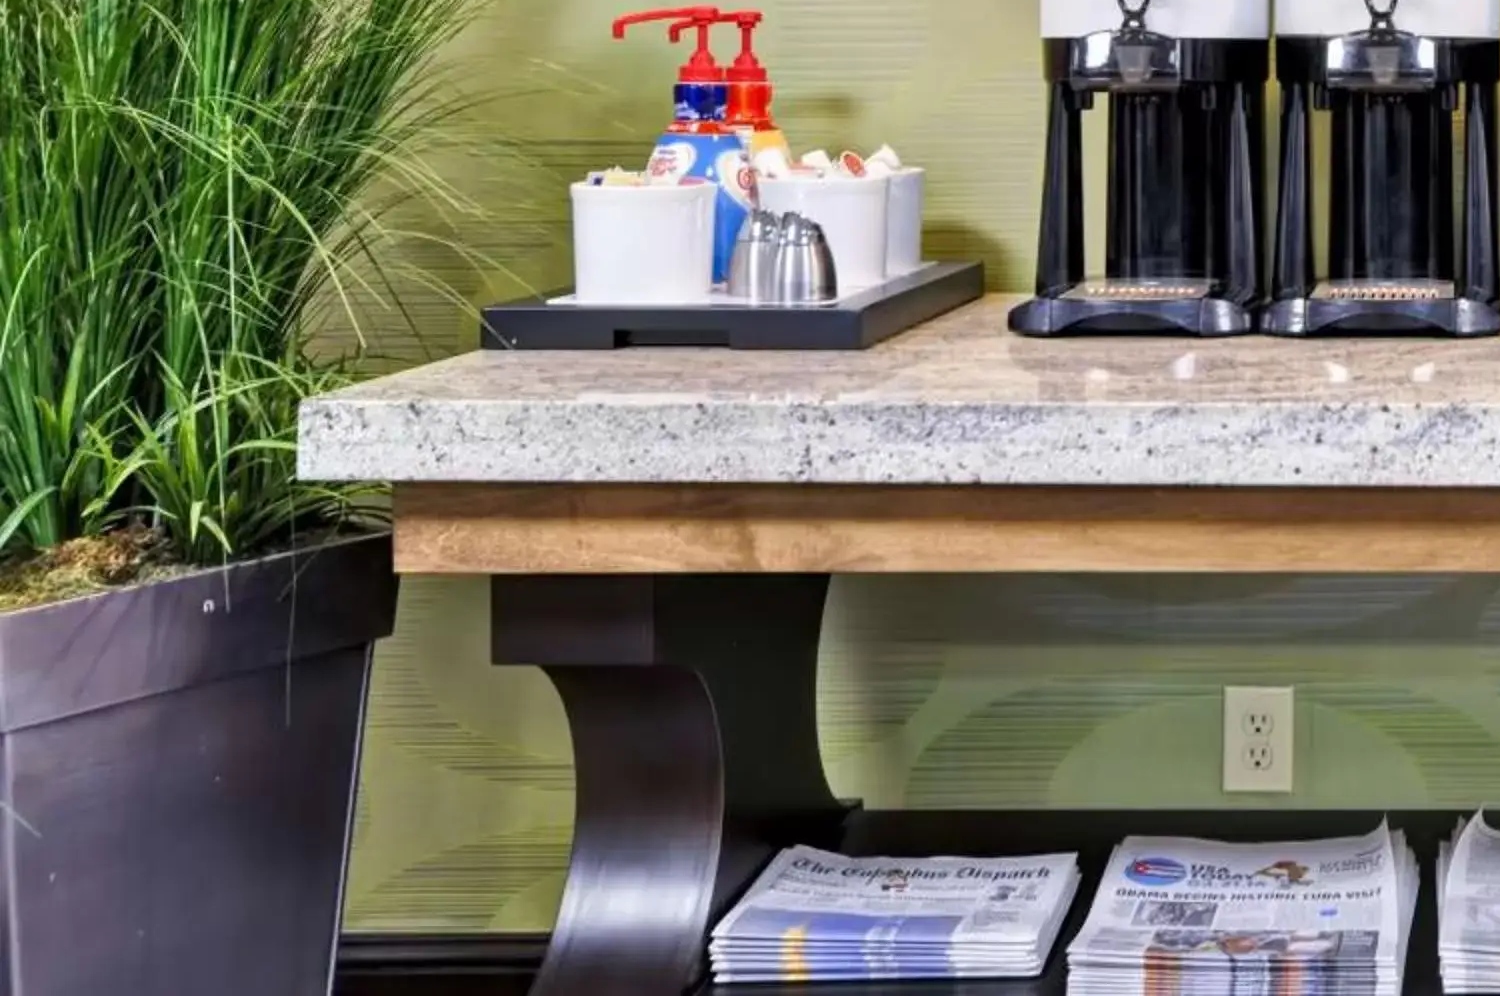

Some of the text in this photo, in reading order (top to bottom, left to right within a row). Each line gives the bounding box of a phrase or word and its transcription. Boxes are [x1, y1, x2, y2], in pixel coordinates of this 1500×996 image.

[792, 858, 835, 874] The
[956, 865, 1051, 881] Dispatch
[1191, 864, 1231, 874] USA
[1115, 888, 1169, 899] OBAMA
